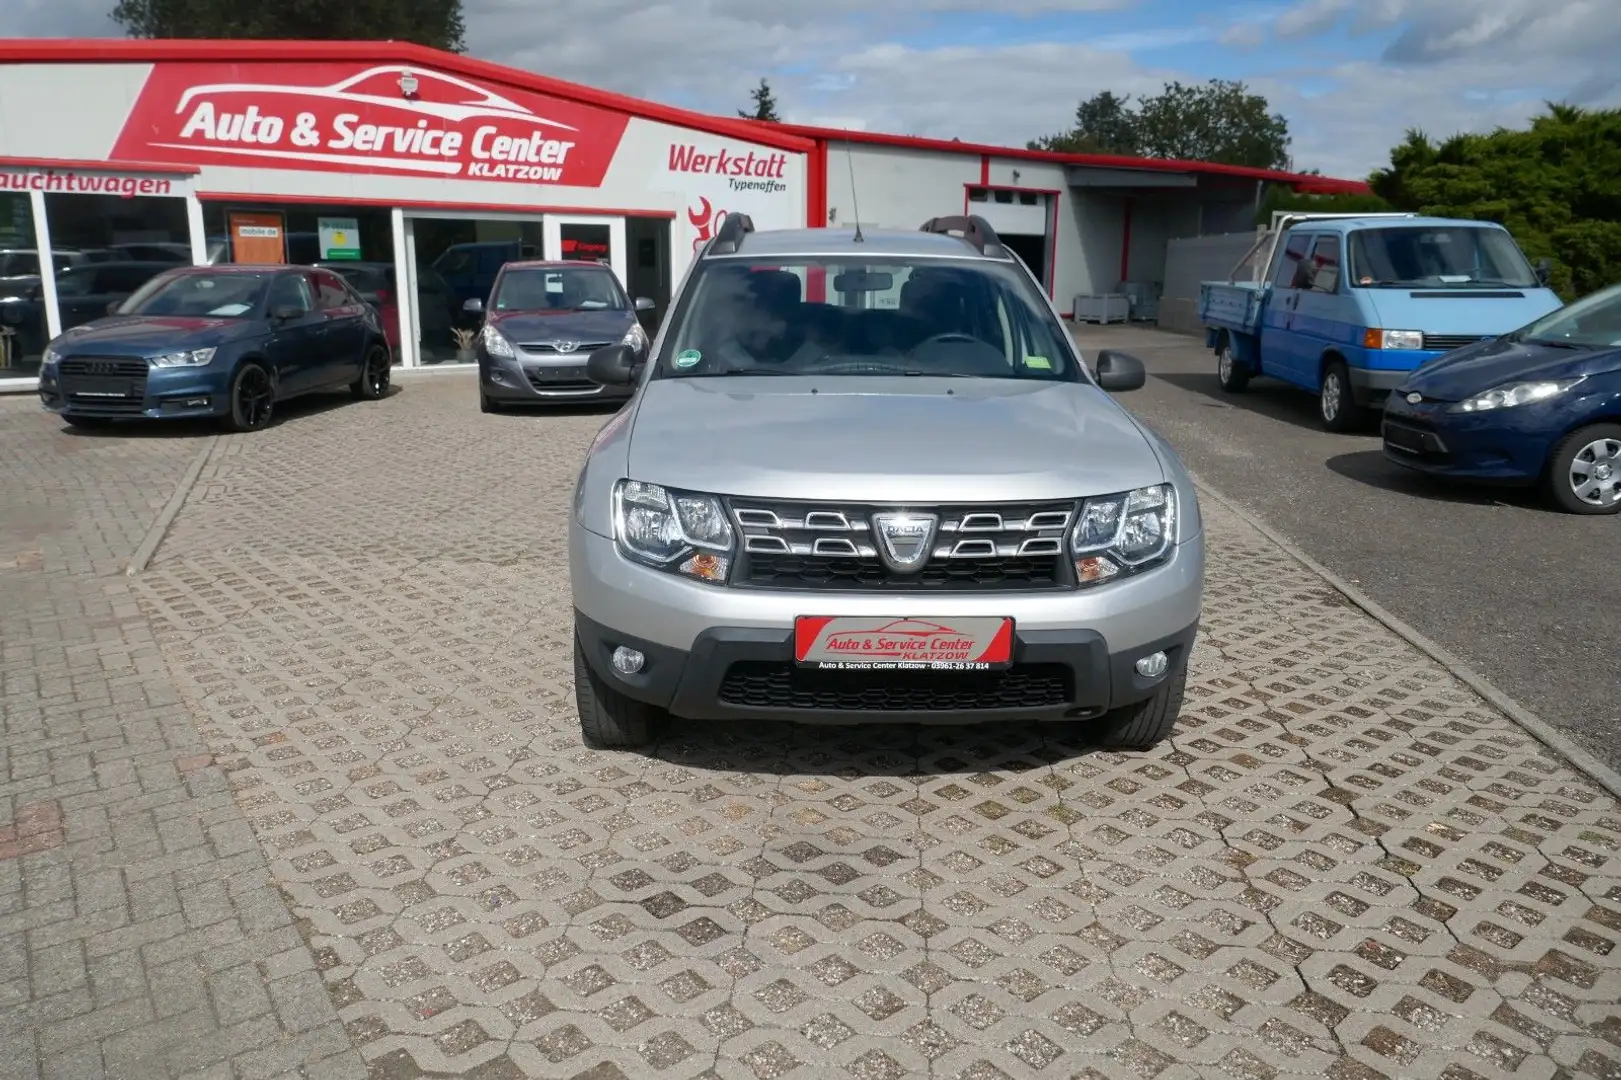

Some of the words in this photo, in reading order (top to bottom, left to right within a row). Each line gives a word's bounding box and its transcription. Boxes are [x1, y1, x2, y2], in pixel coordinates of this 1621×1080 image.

[179, 101, 284, 144] Auto
[290, 112, 320, 147] &
[327, 113, 463, 157] Service
[471, 125, 575, 165] Center
[668, 143, 787, 178] Werkstatt
[467, 162, 562, 181] KLATZOW
[728, 178, 786, 193] Typenoffen
[887, 525, 924, 533] DACIA
[826, 638, 859, 650] Auto
[862, 639, 872, 650] &
[876, 638, 927, 650] Service
[930, 638, 976, 650] Center
[903, 652, 969, 660] KLATZOW
[819, 661, 836, 669] Auto
[965, 662, 975, 670] 37
[975, 662, 989, 670] 814
